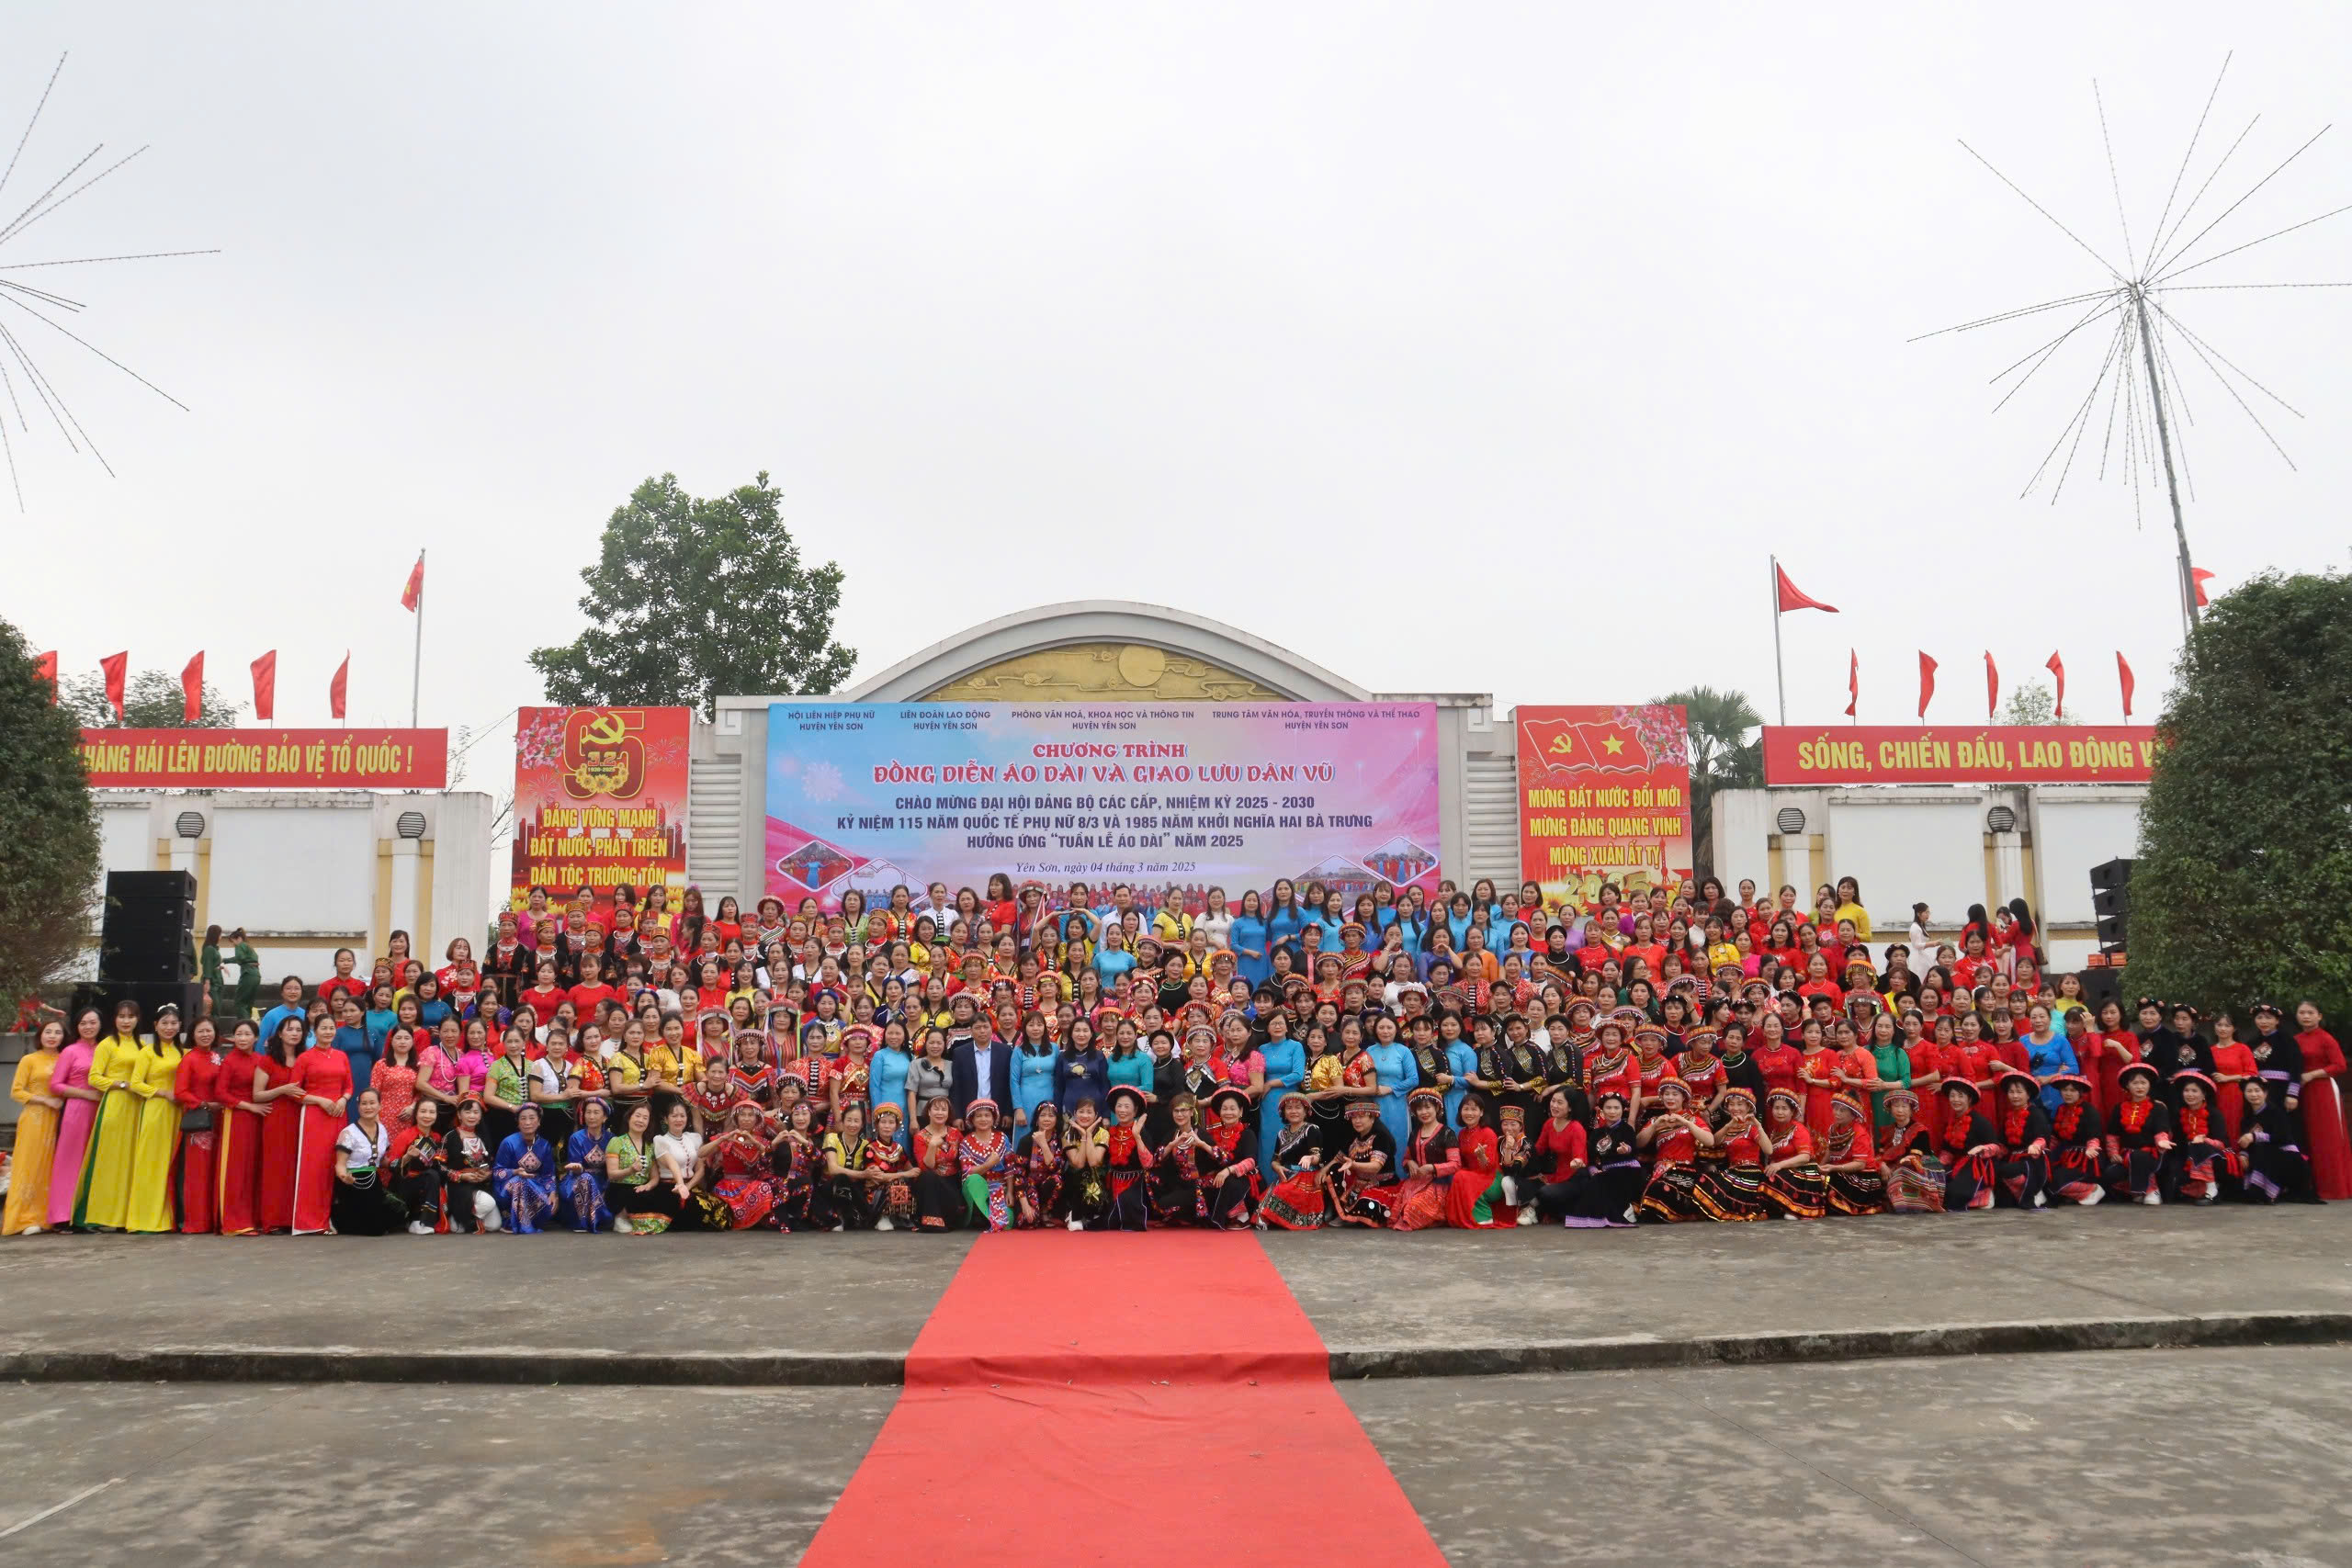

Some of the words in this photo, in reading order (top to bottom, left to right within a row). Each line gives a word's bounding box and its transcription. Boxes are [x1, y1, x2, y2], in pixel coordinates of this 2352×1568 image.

[788, 711, 804, 720] HỘI
[806, 711, 822, 719] LIÊN
[824, 711, 842, 720] HIỆP
[844, 712, 861, 720] PHỤ
[863, 711, 875, 719] NỮ
[900, 710, 917, 718] LIÊN
[920, 710, 944, 718] ĐOÀN
[966, 710, 990, 719] ĐỘNG
[1012, 710, 1042, 718] PHÒNG
[1045, 710, 1062, 718] VĂN
[1065, 710, 1085, 719] HOÁ,
[1114, 711, 1133, 720] HỌC
[1136, 710, 1148, 718] VÀ
[1150, 710, 1180, 718] THÔNG
[1242, 710, 1259, 718] TÂM
[1261, 710, 1279, 718] VĂN
[1281, 710, 1303, 719] HÓA,
[1305, 707, 1333, 718] TRUYỀN
[1337, 710, 1365, 718] THÔNG
[1368, 710, 1379, 718] VÀ
[1381, 707, 1396, 718] THỂ
[799, 722, 826, 732] HUYỆN
[829, 722, 843, 730] YÊN
[913, 721, 940, 732] HUYỆN
[943, 721, 957, 729] YÊN
[1072, 721, 1099, 731] HUYỆN
[1102, 721, 1116, 729] YÊN
[1285, 721, 1312, 731] HUYỆN
[1314, 721, 1329, 729] YÊN
[135, 738, 163, 773] HÁI
[168, 739, 200, 773] LÊN
[204, 738, 261, 773] ĐƯỜNG
[266, 733, 300, 773] BẢO
[306, 739, 325, 779] VỆ
[332, 733, 351, 773] TỔ
[356, 735, 401, 774] QUỐC
[1033, 741, 1117, 758] CHƯƠNG
[1122, 740, 1186, 758] TRÌNH
[1798, 732, 1871, 773] SỐNG,
[1879, 732, 1951, 768] CHIẾN
[1958, 732, 2013, 772] ĐẤU,
[2018, 741, 2064, 768] LAO
[2070, 736, 2134, 774] ĐỘNG
[874, 760, 935, 784] ĐỒNG
[943, 760, 995, 782] DIỄN
[1003, 762, 1037, 783] ÁO
[1044, 762, 1083, 783] DÀI
[1091, 762, 1126, 783] VÀ
[1134, 765, 1191, 784] GIAO
[1198, 763, 1240, 782] LƯU
[1248, 762, 1294, 782] DÂN
[1302, 761, 1333, 782] VŨ
[896, 795, 932, 809] CHÀO
[936, 795, 977, 809] MỪNG
[981, 797, 1003, 812] ĐẠI
[1008, 795, 1030, 812] HỘI
[1035, 794, 1072, 809] ĐẢNG
[1077, 795, 1094, 812] BỘ
[1099, 795, 1126, 809] CÁC
[1130, 792, 1161, 810] CẤP,
[1166, 795, 1210, 811] NHIỆM
[1215, 794, 1231, 809] KỲ
[1236, 796, 1269, 808] 2025
[1282, 796, 1315, 808] 2030
[1528, 785, 1566, 807] MỪNG
[1569, 784, 1592, 807] ĐẤT
[1596, 785, 1630, 807] NƯỚC
[1633, 782, 1653, 807] ĐỔI
[1657, 784, 1681, 807] MỚI
[543, 802, 577, 828] ĐẢNG
[581, 806, 615, 828] VỮNG
[618, 808, 658, 829] MẠNH
[837, 813, 854, 829] KỶ
[859, 815, 894, 832] NIỆM
[899, 817, 922, 829] 115
[927, 814, 958, 829] NĂM
[963, 812, 1000, 830] QUỐC
[1004, 812, 1020, 829] TẾ
[1023, 817, 1050, 832] PHỤ
[1057, 814, 1075, 829] NỮ
[1078, 816, 1099, 829] 8/3
[1103, 814, 1121, 829] VÀ
[1125, 816, 1158, 829] 1985
[1162, 814, 1193, 828] NĂM
[1198, 812, 1229, 828] KHỞI
[1233, 813, 1275, 828] NGHĨA
[1279, 816, 1302, 828] HAI
[1306, 813, 1324, 828] BÀ
[1329, 814, 1373, 828] TRƯNG
[1530, 814, 1566, 837] MỪNG
[1571, 812, 1604, 837] ĐẢNG
[1609, 818, 1649, 838] QUANG
[1653, 818, 1681, 836] VINH
[530, 831, 554, 857] ĐẤT
[558, 834, 593, 857] NƯỚC
[595, 835, 629, 857] PHÁT
[630, 830, 668, 857] TRIỂN
[967, 831, 1013, 848] HƯỞNG
[1018, 832, 1046, 848] ỨNG
[1098, 830, 1114, 848] LỄ
[1118, 832, 1136, 848] ÁO
[1175, 832, 1206, 847] NĂM
[1211, 835, 1244, 847] 2025
[1550, 842, 1588, 865] MỪNG
[1589, 843, 1624, 865] XUÂN
[1628, 840, 1643, 865] ẤT
[1645, 845, 1660, 869] TỴ
[531, 863, 557, 886] DÂN
[560, 863, 583, 889] TỘC
[588, 863, 639, 886] TRƯỜNG
[640, 861, 665, 886] TỒN
[1016, 863, 1035, 872] Yên
[1039, 863, 1060, 873] Sơn,
[1064, 863, 1088, 874] ngày
[1091, 863, 1102, 872] 04
[1106, 863, 1135, 874] tháng
[1137, 863, 1143, 872] 3
[1147, 863, 1168, 871] năm
[1171, 863, 1195, 871] 2025
